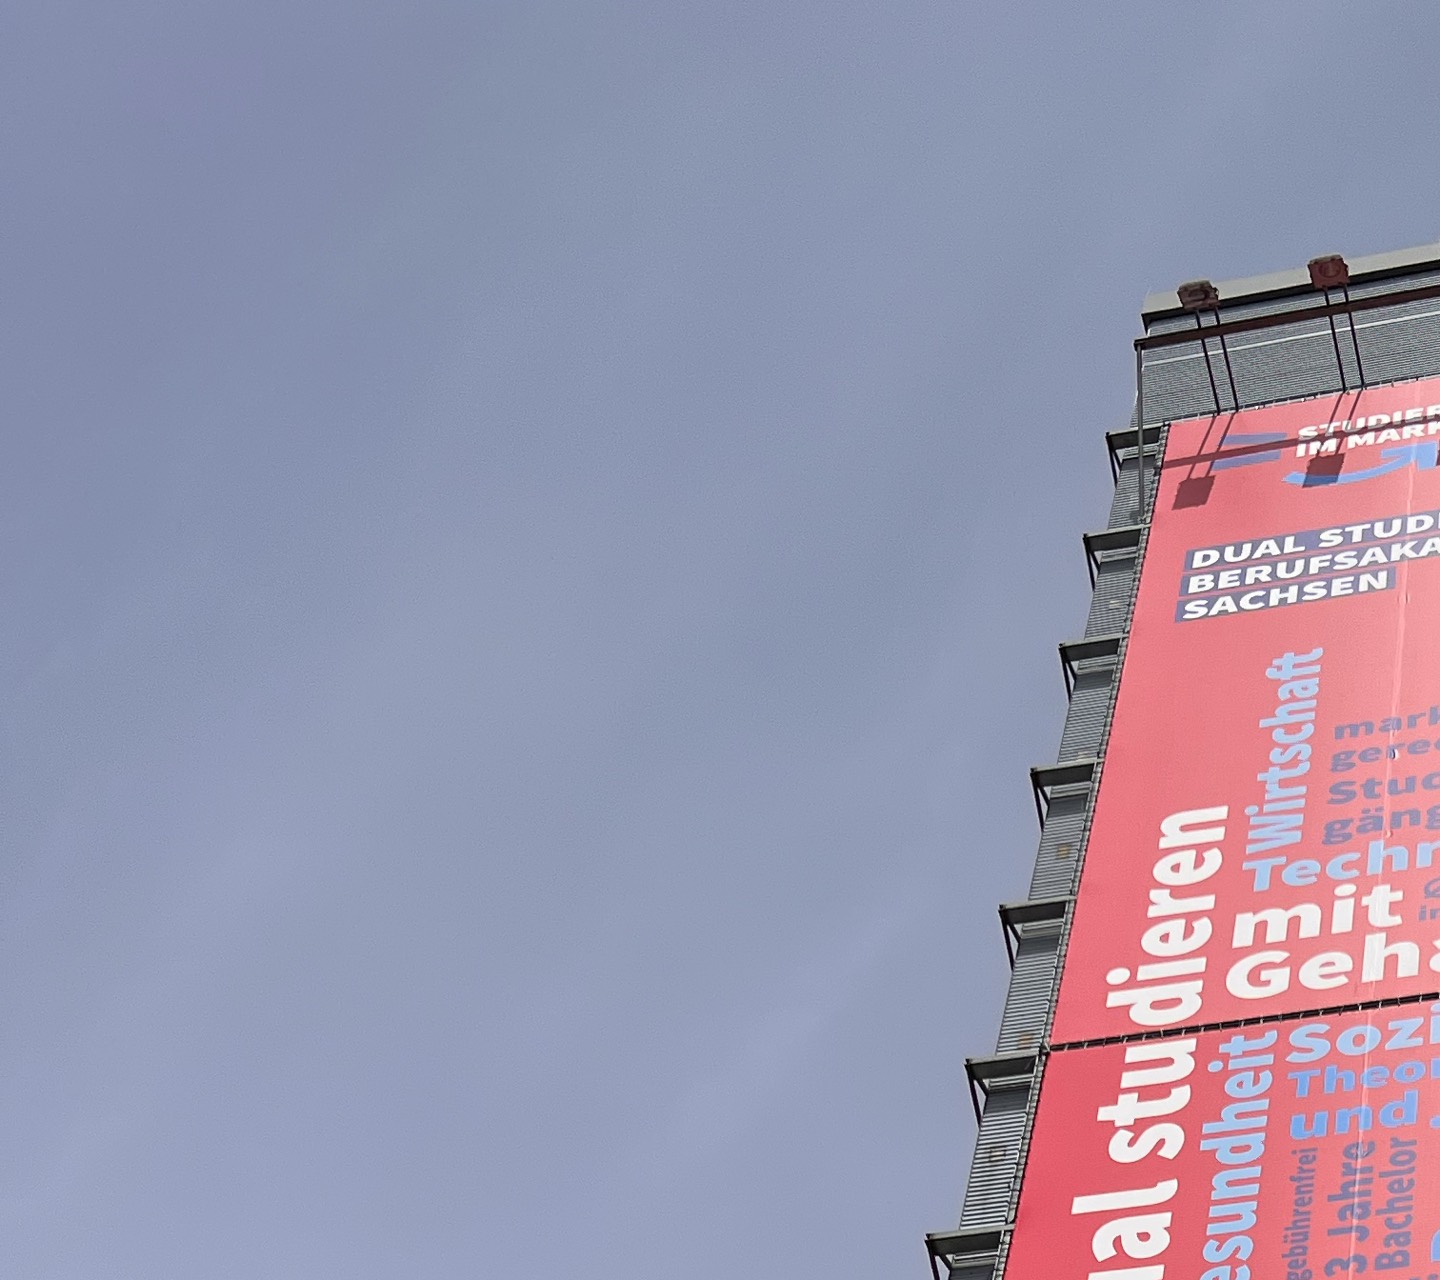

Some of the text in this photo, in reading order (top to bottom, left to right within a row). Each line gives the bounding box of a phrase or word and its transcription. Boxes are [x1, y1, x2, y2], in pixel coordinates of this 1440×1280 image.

[1296, 439, 1339, 457] IM
[1191, 536, 1305, 569] DUAL
[1182, 570, 1389, 620] SACHSEN
[1243, 647, 1324, 854] Wirtschaft
[1232, 882, 1404, 949] mit
[1096, 805, 1229, 1164] studieren
[1290, 1090, 1419, 1141] und
[1323, 1139, 1376, 1278] 3 Jahre
[1373, 1136, 1418, 1272] Bachelor
